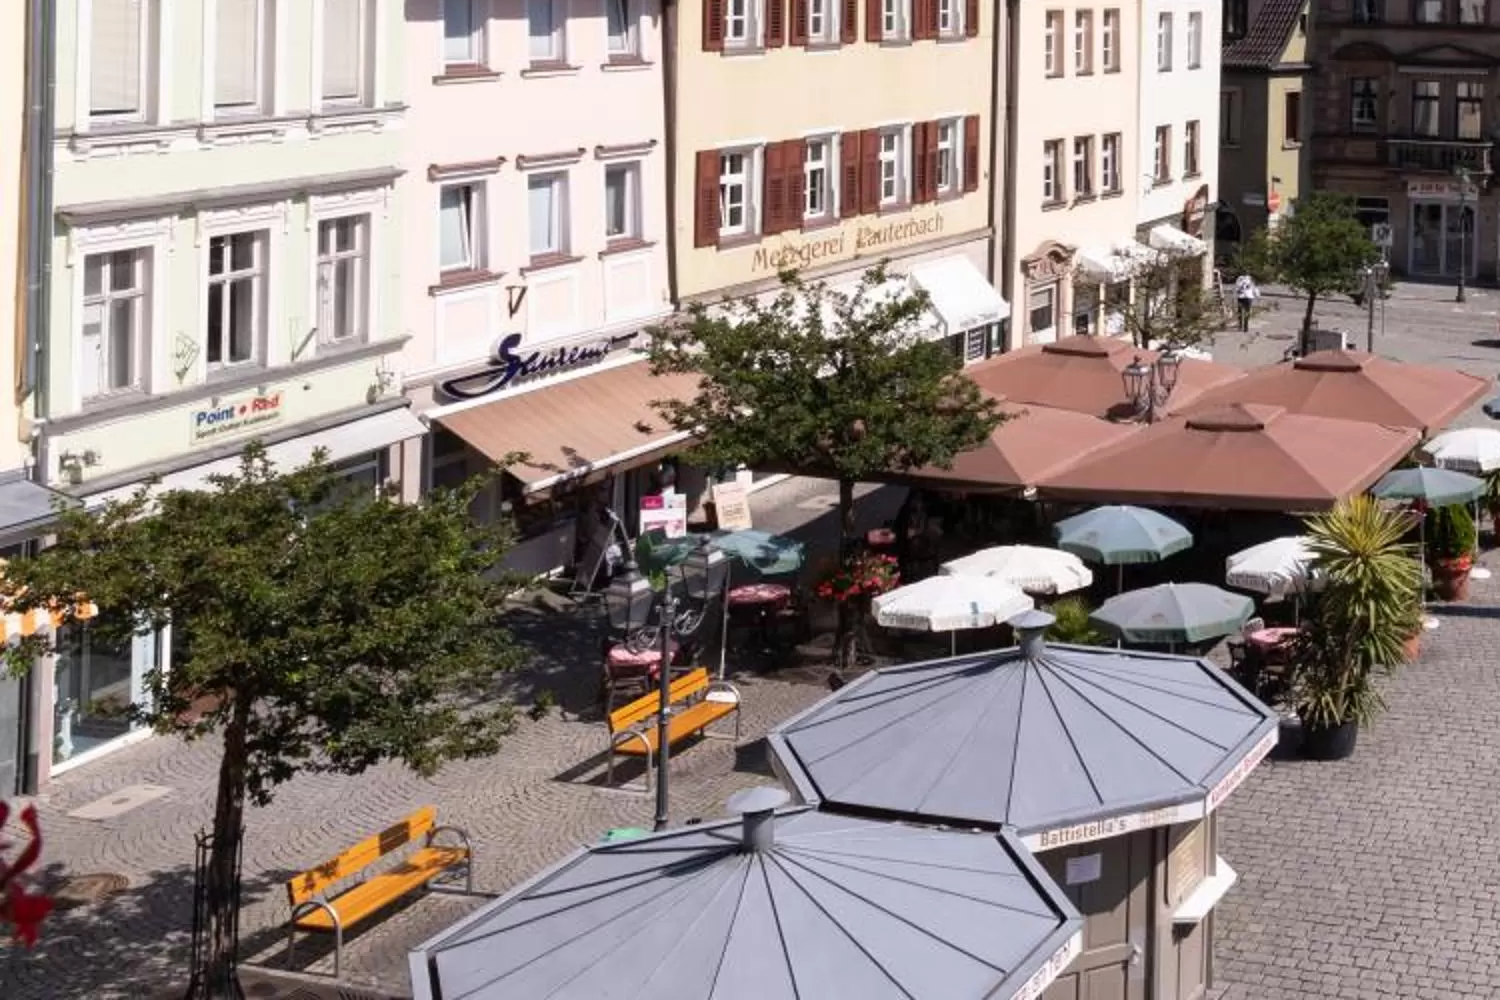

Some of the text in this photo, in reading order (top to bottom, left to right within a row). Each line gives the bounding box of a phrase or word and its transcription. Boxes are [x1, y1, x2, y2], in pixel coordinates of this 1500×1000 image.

[752, 231, 845, 272] Metzgerei
[196, 405, 235, 427] Point
[1039, 817, 1127, 847] Battistella's
